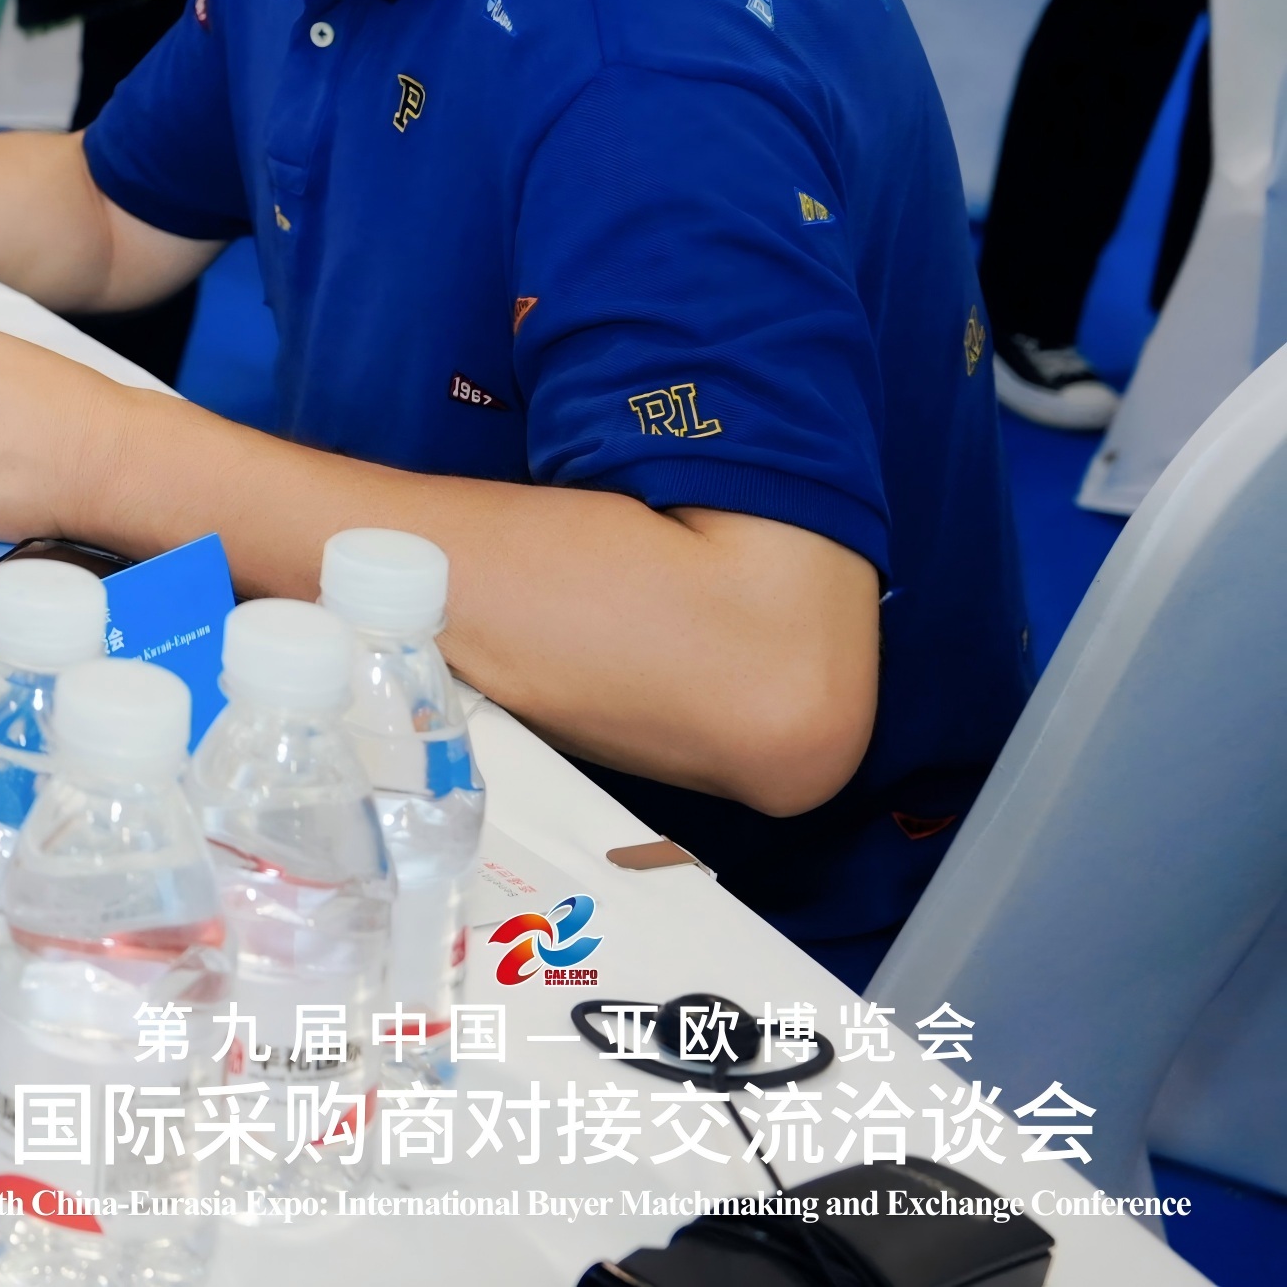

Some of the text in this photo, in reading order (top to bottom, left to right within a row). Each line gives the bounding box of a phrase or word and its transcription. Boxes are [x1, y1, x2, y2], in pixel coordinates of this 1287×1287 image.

[393, 73, 427, 132] P
[452, 376, 493, 405] 1967
[628, 383, 723, 438] RL
